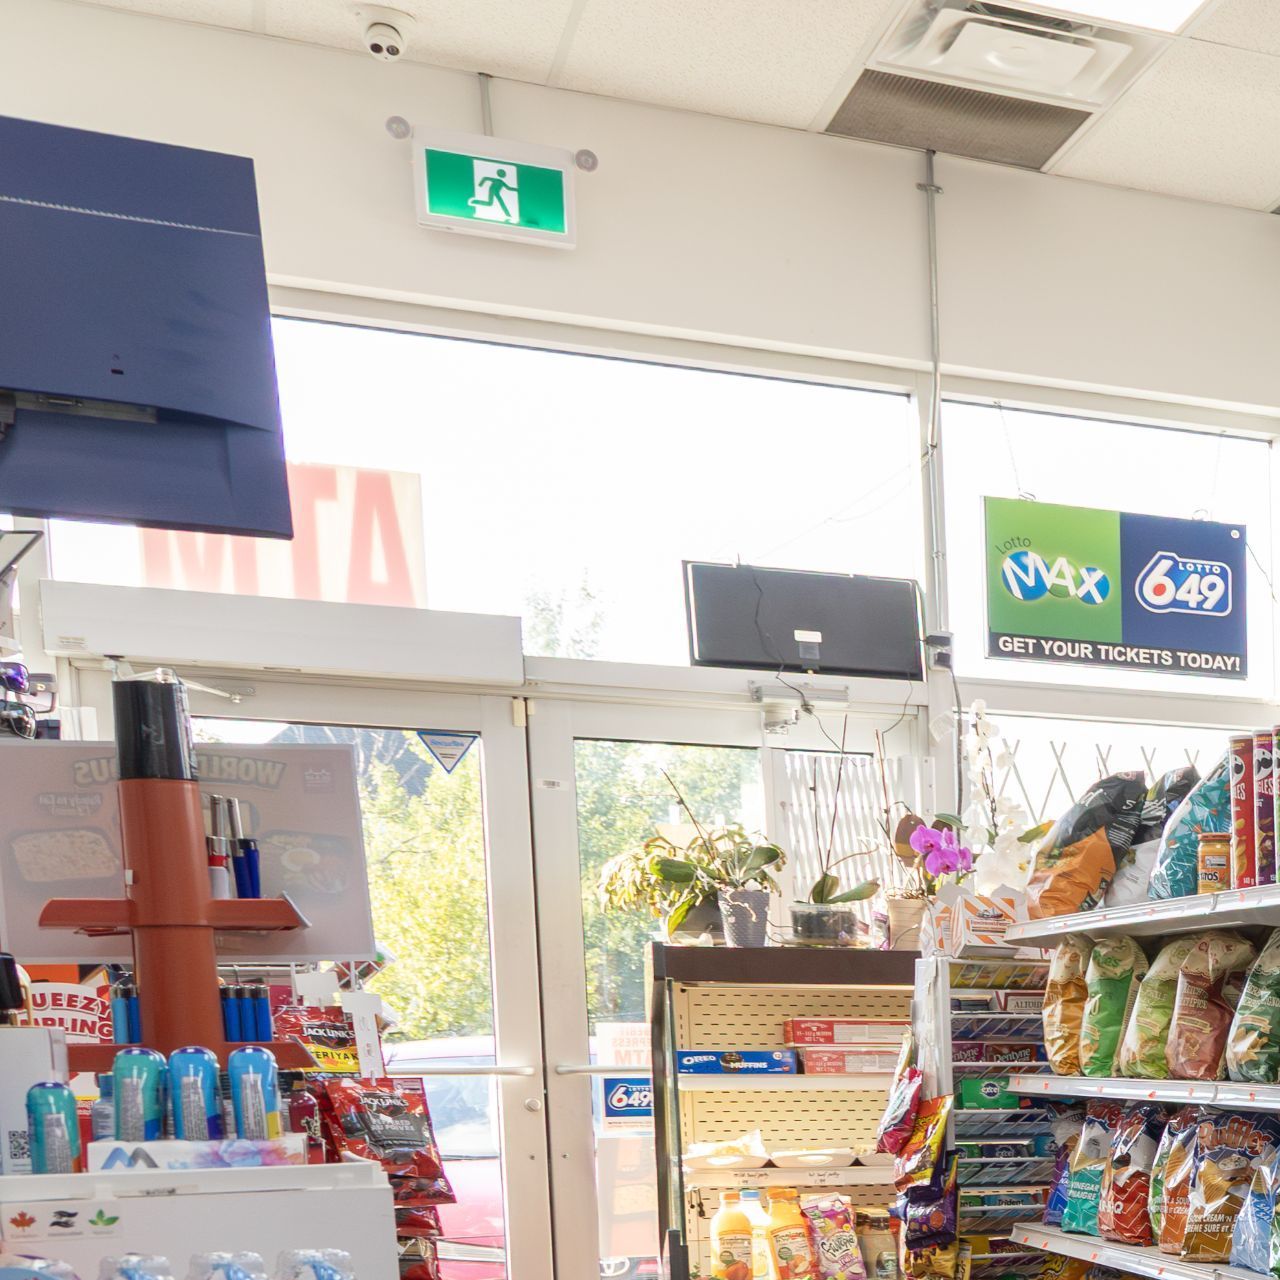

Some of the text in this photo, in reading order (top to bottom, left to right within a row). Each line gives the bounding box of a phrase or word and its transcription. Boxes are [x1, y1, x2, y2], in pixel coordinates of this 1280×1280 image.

[995, 536, 1031, 554] Lotto
[1178, 562, 1221, 573] LOTTO
[999, 637, 1241, 671] GET YOUR TICKETS TODAY!
[303, 1027, 327, 1037] JACK
[682, 1054, 716, 1065] OREO
[993, 1046, 1031, 1062] Dentyne
[730, 1061, 768, 1069] MUFFINS
[998, 1198, 1024, 1206] Trident
